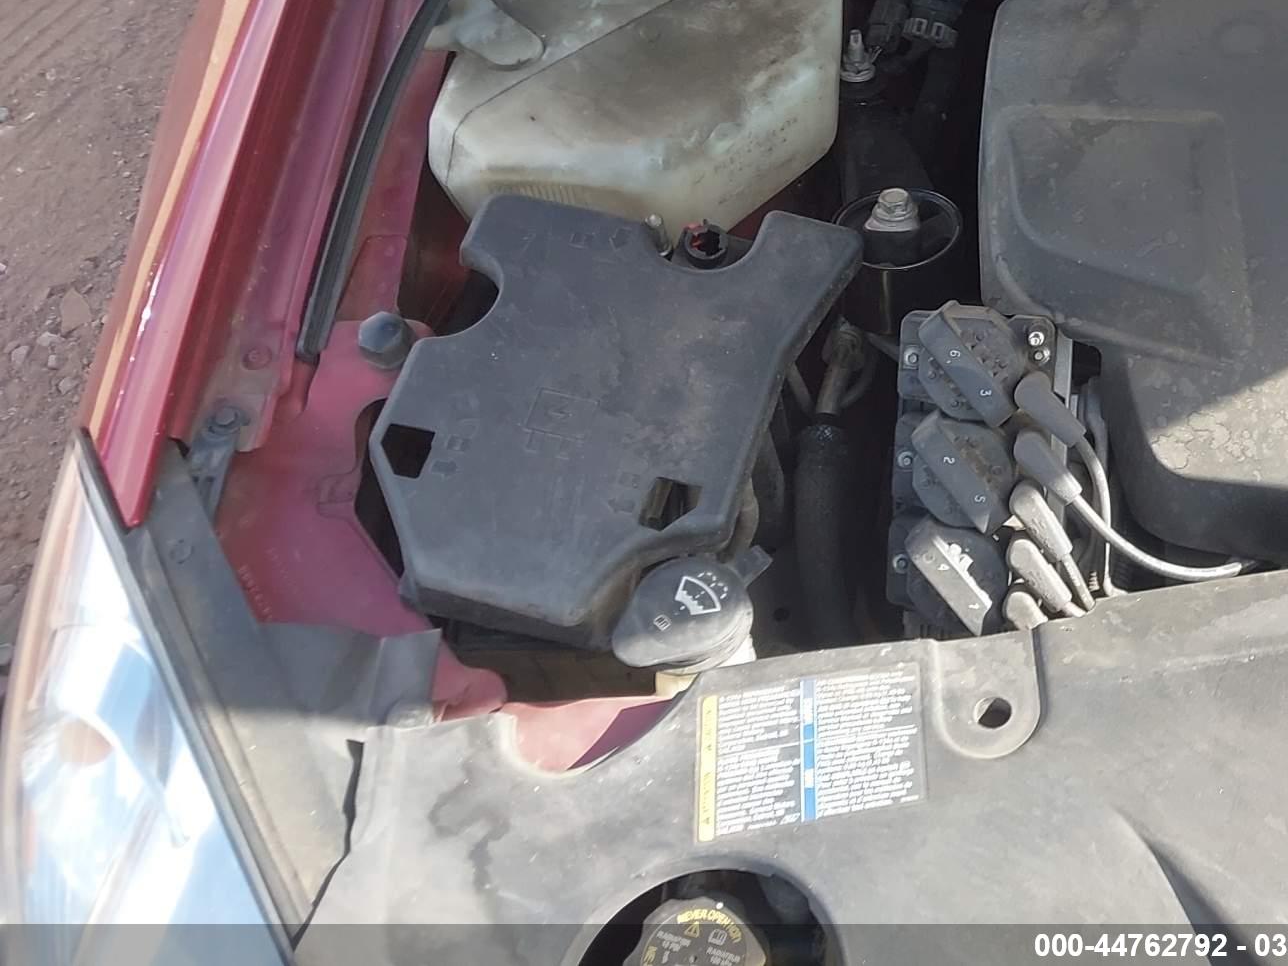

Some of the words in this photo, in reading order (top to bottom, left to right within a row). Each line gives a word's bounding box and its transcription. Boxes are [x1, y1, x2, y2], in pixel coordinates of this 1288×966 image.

[980, 389, 992, 397] 3
[943, 456, 956, 464] 2
[974, 494, 986, 503] 5
